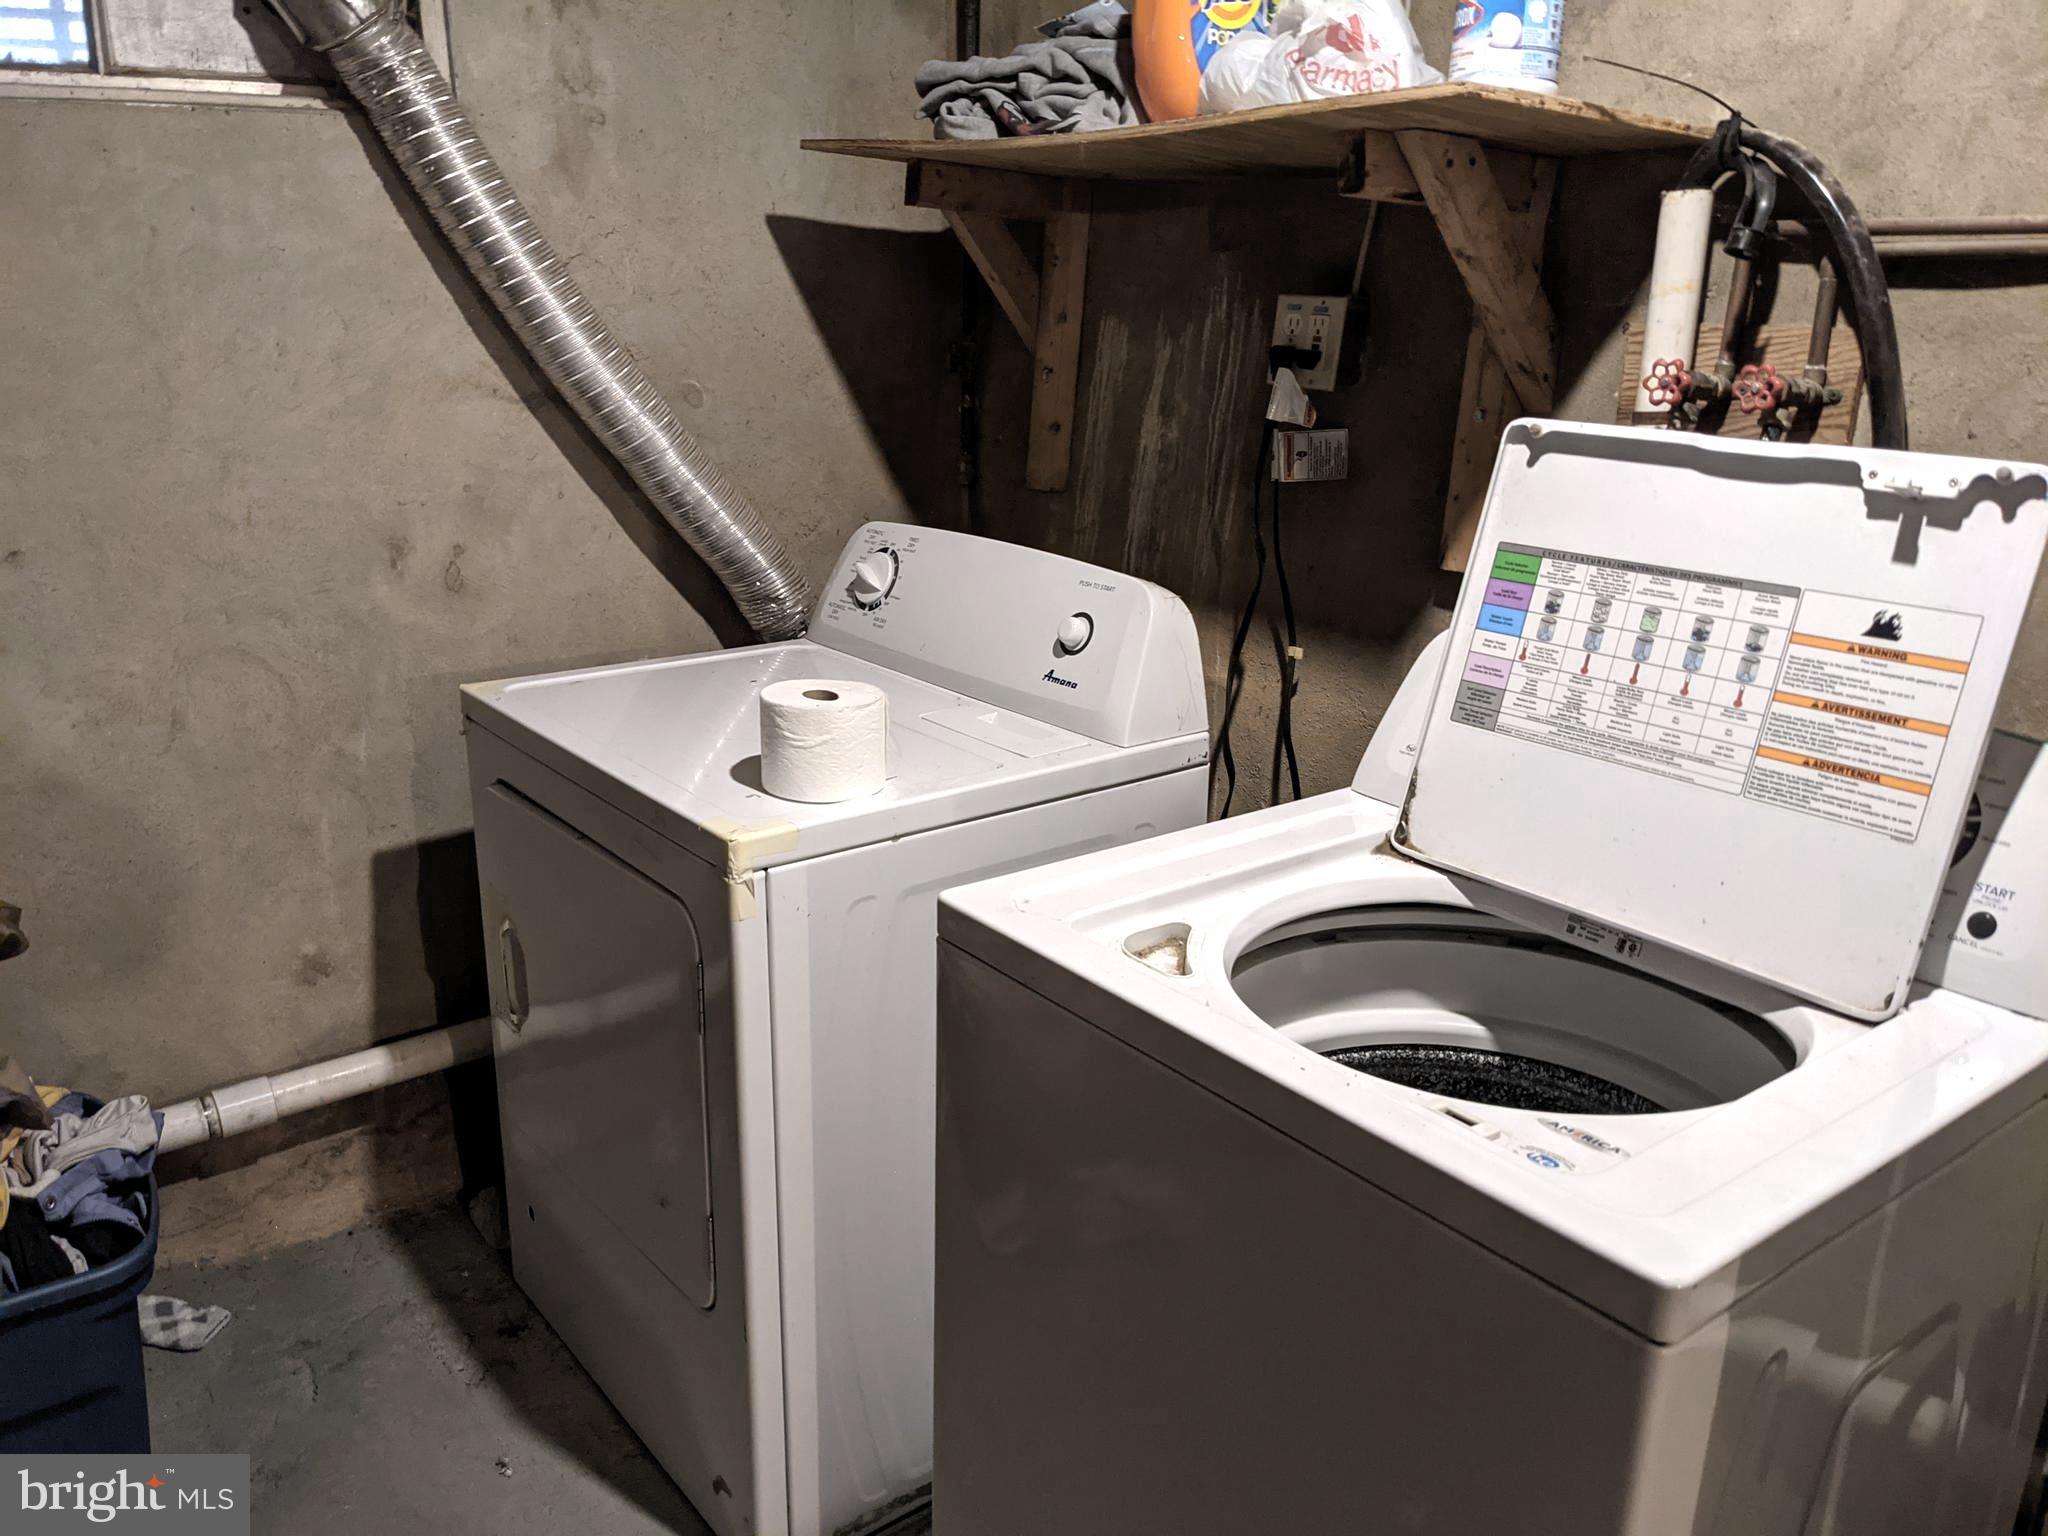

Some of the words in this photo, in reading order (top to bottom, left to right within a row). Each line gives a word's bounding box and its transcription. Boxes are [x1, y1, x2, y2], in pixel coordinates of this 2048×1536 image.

[1858, 644, 1908, 662] WARNING
[1041, 669, 1078, 689] Amana
[1822, 701, 1909, 727] AVERTISSEMENT
[1812, 759, 1880, 783] ADVERTENCIA
[1974, 881, 2016, 901] START
